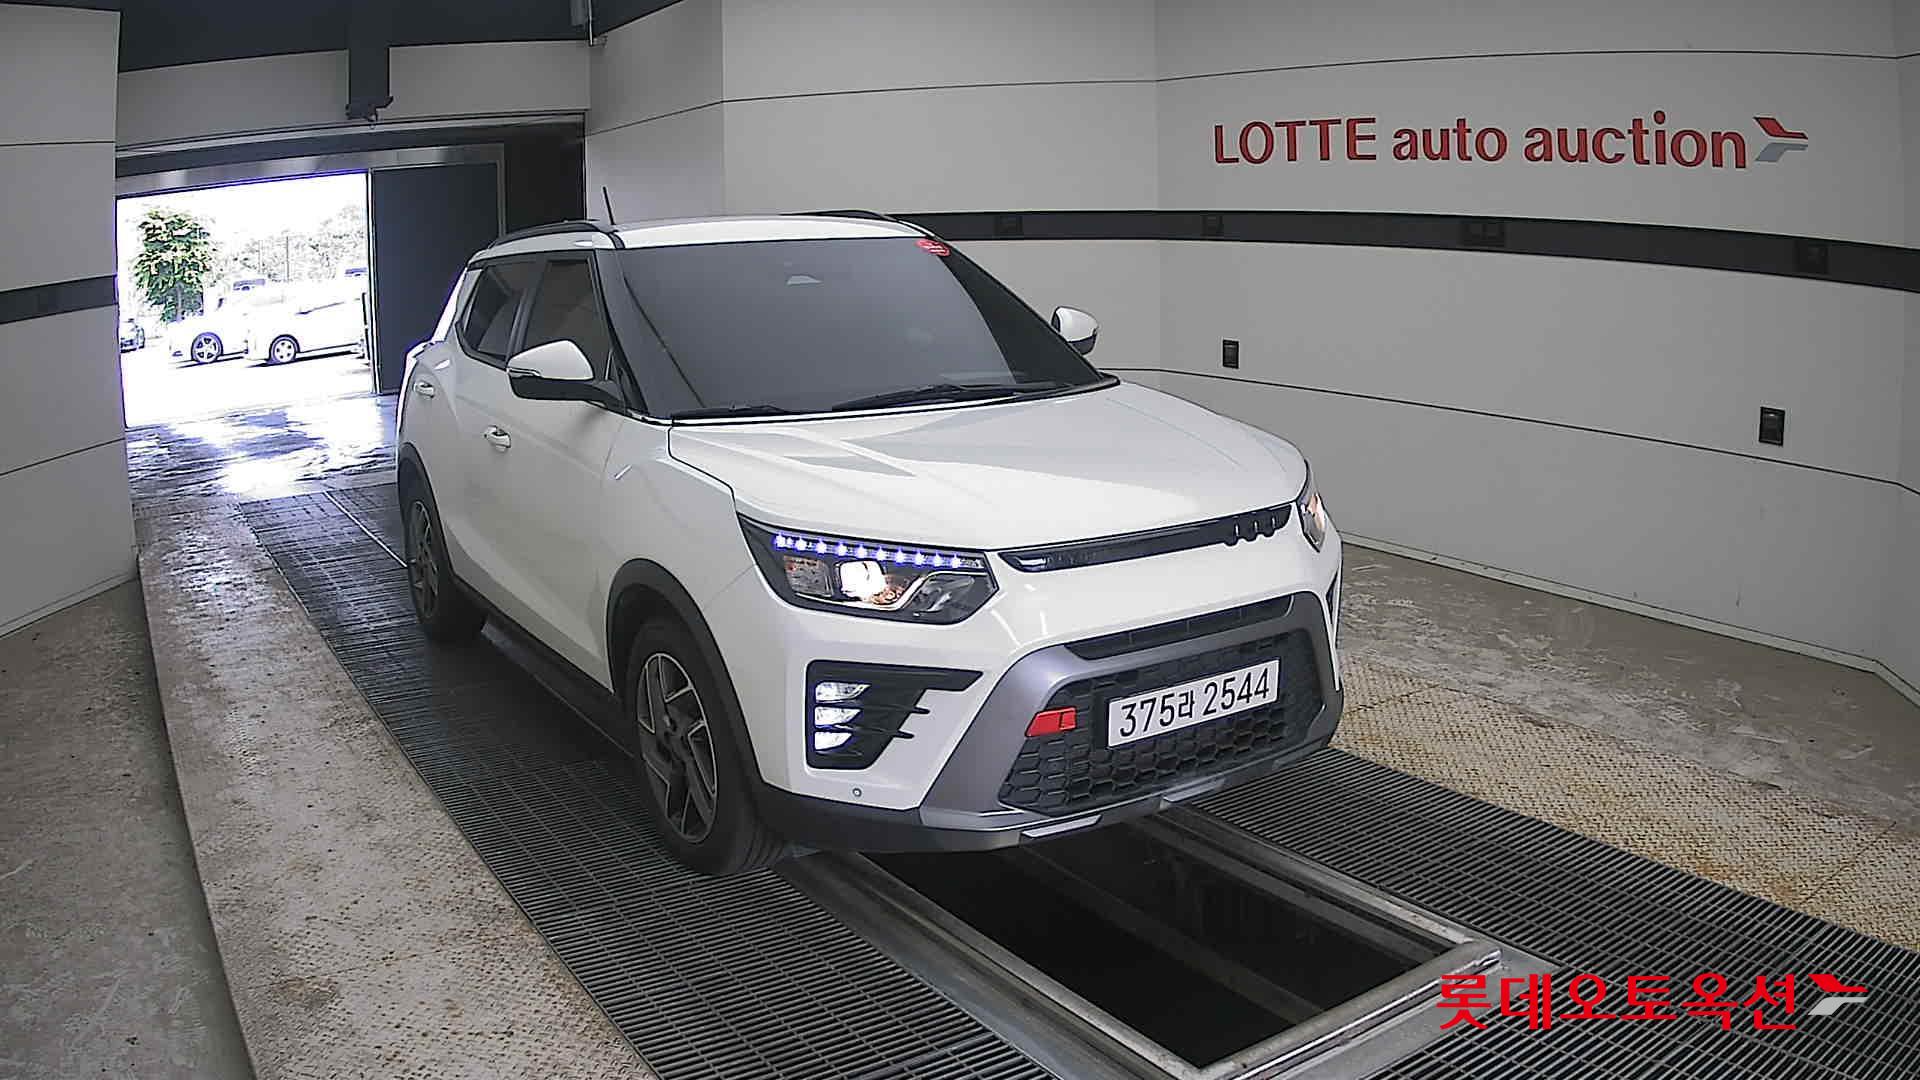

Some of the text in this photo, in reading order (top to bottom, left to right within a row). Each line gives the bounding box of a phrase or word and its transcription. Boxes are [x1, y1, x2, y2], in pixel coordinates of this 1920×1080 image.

[1214, 110, 1747, 168] LOTTE auto auction
[1119, 667, 1270, 737] 375라 2544
